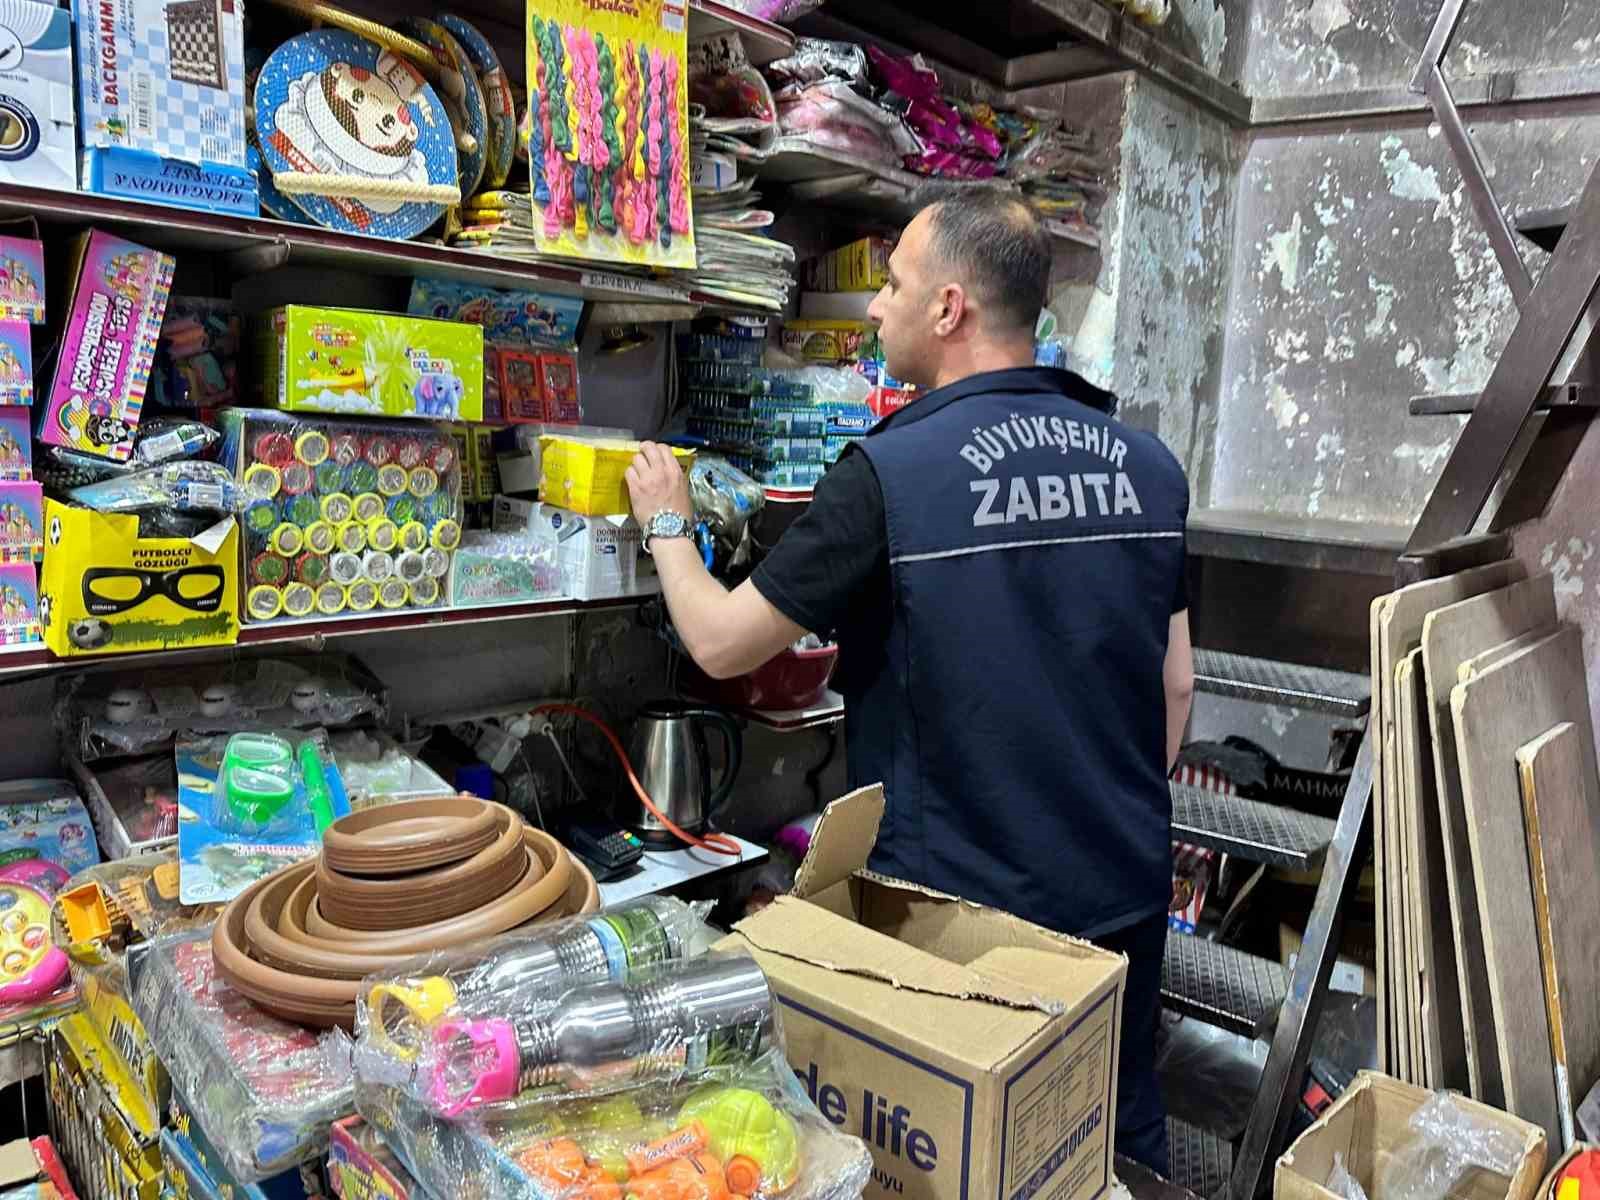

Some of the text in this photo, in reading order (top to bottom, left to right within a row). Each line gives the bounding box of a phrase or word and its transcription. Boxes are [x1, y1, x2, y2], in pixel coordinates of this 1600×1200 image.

[128, 175, 243, 204] BACKGAMMON
[959, 412, 1128, 475] BÜYÜKŞEHİR
[969, 472, 1143, 527] ZABITA
[132, 548, 192, 558] FUTBOLCU
[862, 1089, 938, 1172] life
[869, 1167, 904, 1195] uyu
